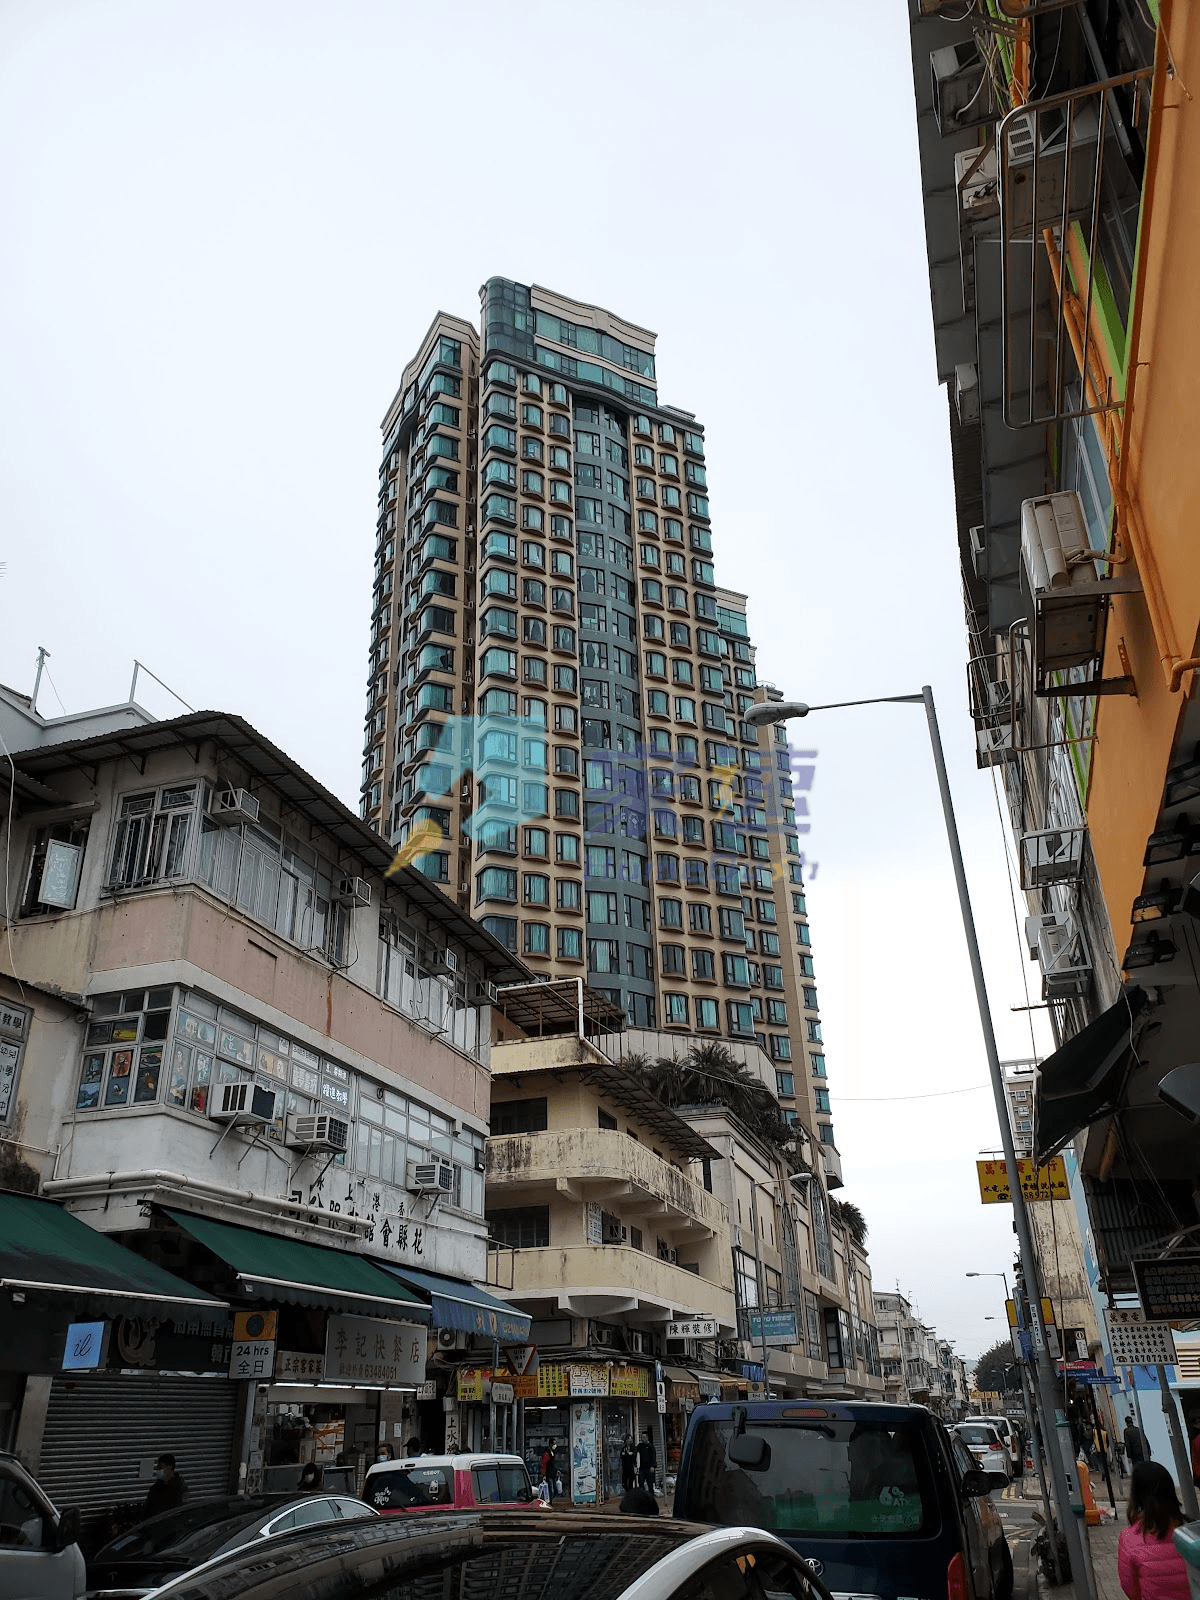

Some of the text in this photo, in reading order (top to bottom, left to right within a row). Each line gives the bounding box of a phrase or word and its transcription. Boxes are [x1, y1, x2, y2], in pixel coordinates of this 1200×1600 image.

[236, 1344, 270, 1356] 24 hrs
[335, 1328, 420, 1364] 李記快餐店
[237, 1360, 265, 1375] 全日
